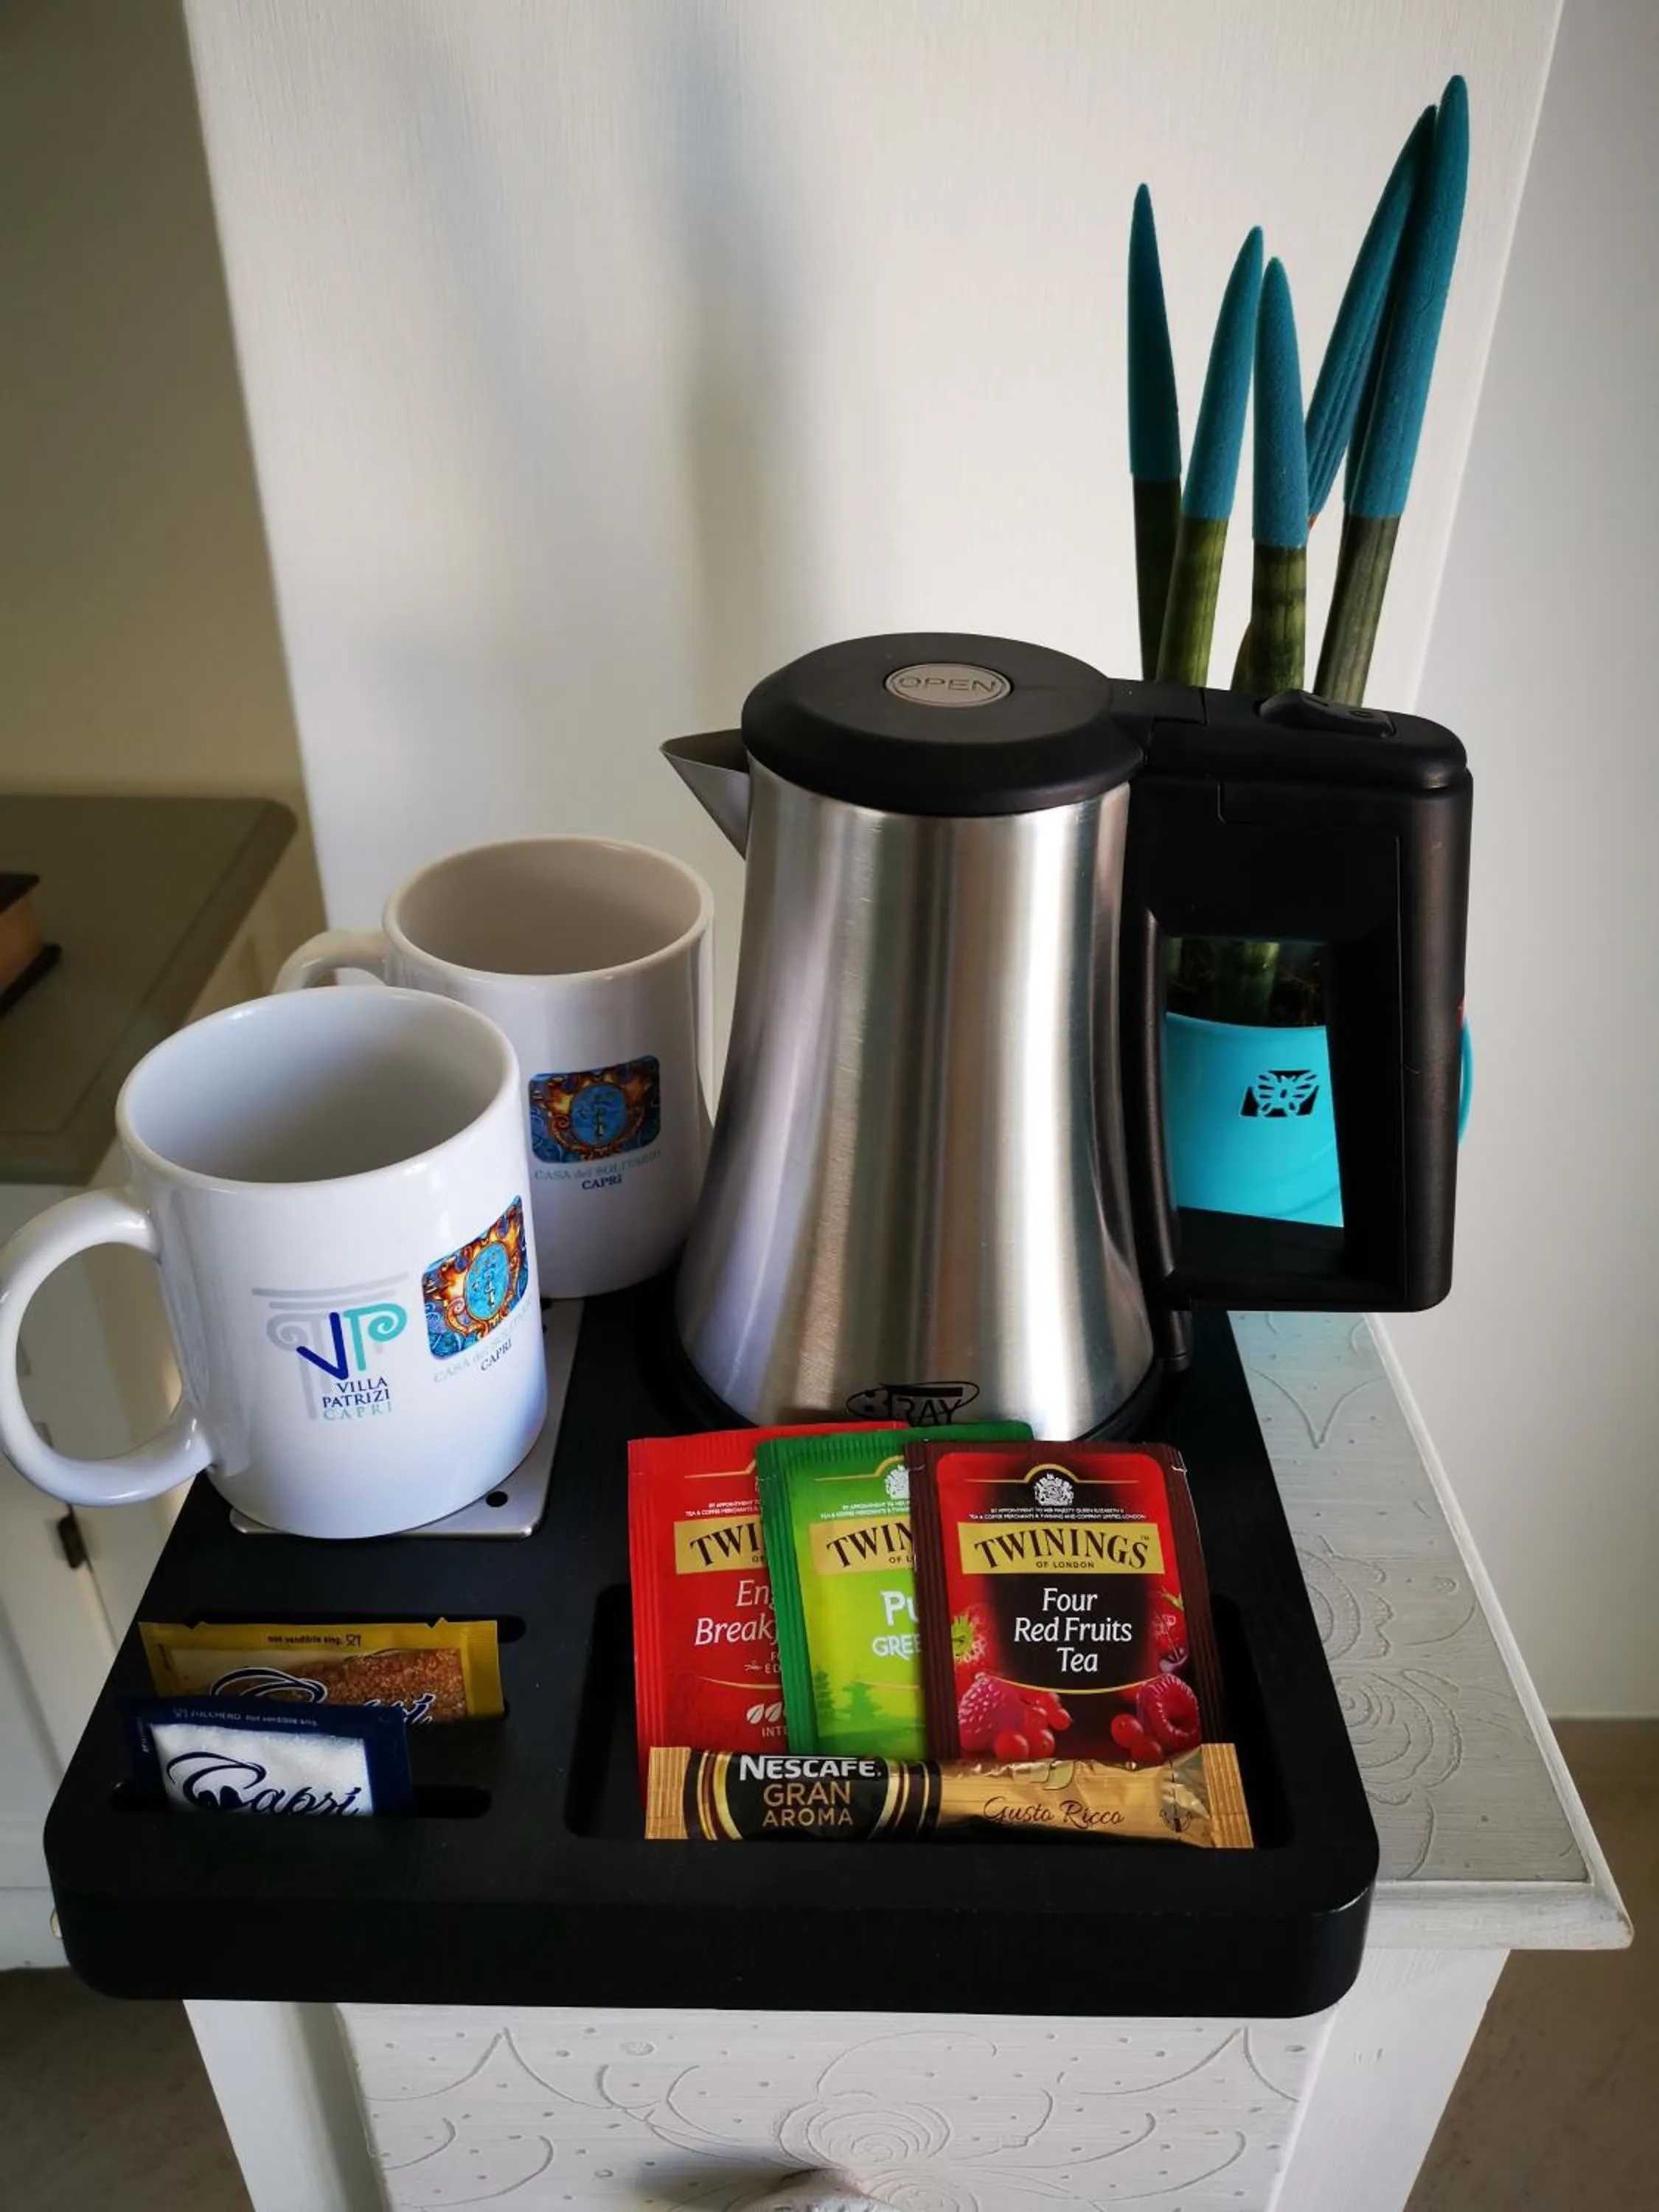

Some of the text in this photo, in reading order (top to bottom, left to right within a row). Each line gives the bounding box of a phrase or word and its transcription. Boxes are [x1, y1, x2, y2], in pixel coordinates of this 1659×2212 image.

[898, 675, 996, 693] OPEN
[581, 1173, 623, 1191] CAPRI
[480, 1338, 513, 1371] CAPRI
[335, 1376, 388, 1394] VILLA
[321, 1388, 391, 1408] PATRIZI
[323, 1401, 393, 1422] CAPRI
[973, 1528, 1148, 1570] TWININGS
[1035, 1561, 1095, 1569] OF LONDON
[735, 1579, 776, 1611] En
[1041, 1587, 1099, 1612] Four
[694, 1612, 778, 1646] Break
[1013, 1615, 1133, 1643] Red Fruits
[1056, 1646, 1099, 1672] Tea
[763, 1780, 852, 1807] GRAN
[762, 1806, 854, 1828] AROMA
[983, 1796, 1126, 1829] Gusto Ricco
